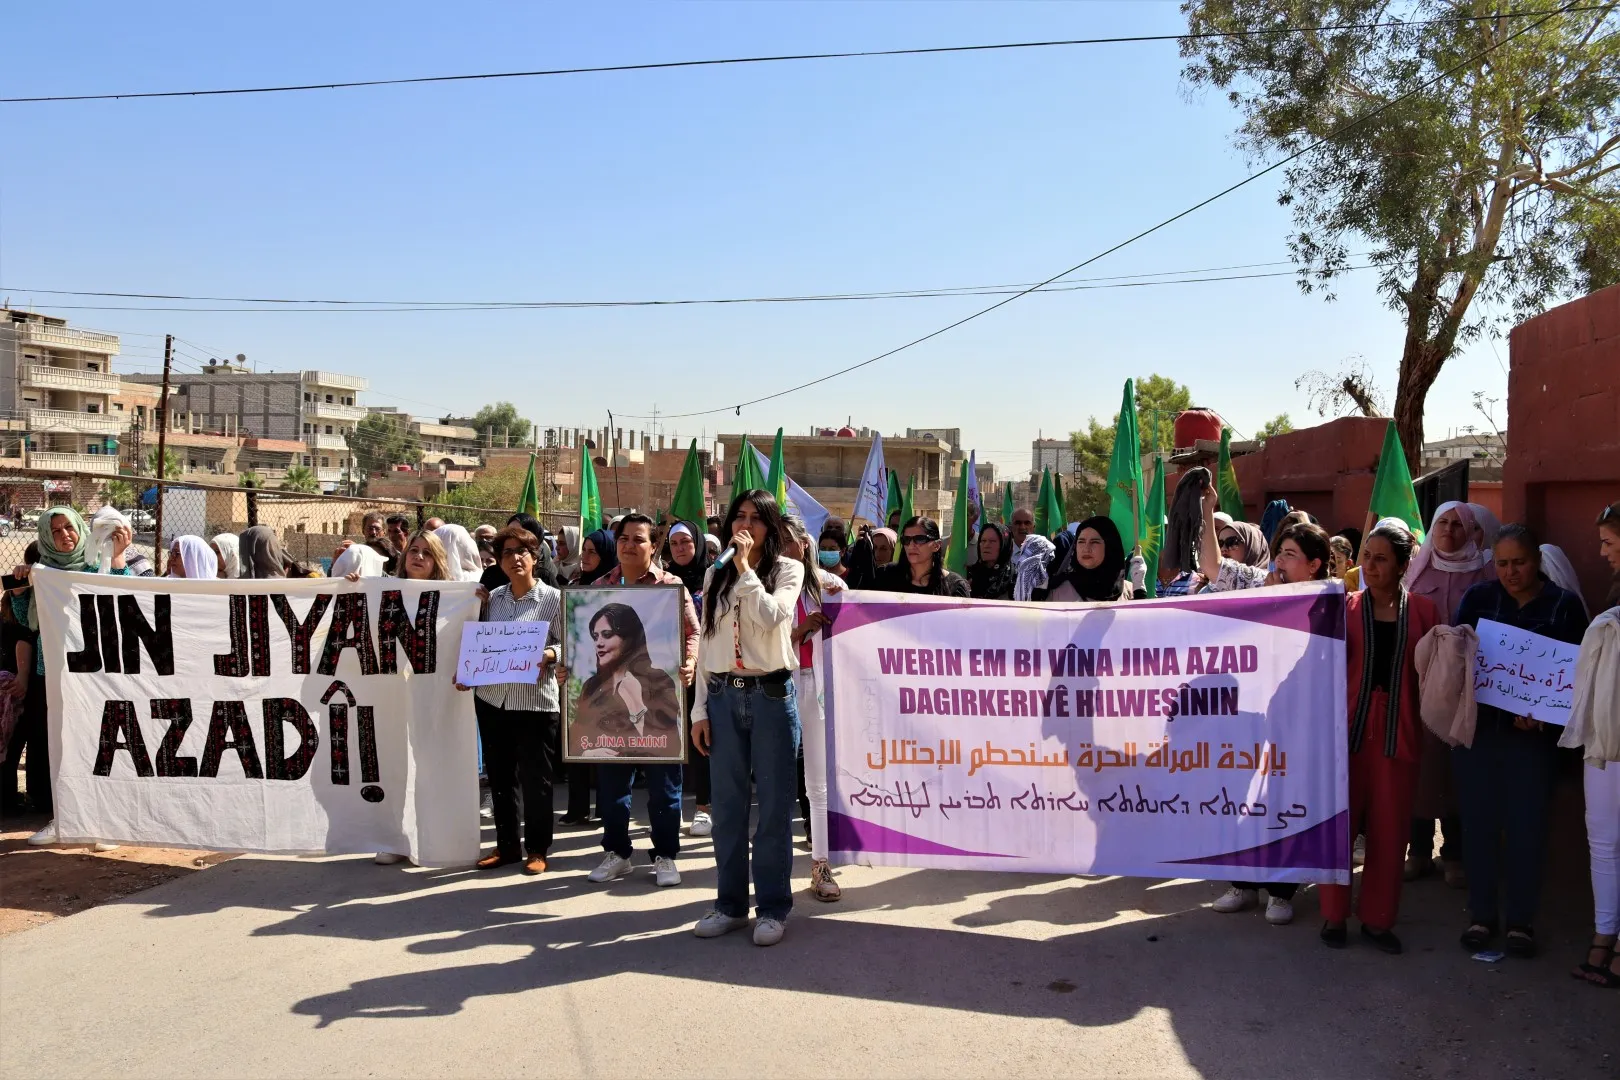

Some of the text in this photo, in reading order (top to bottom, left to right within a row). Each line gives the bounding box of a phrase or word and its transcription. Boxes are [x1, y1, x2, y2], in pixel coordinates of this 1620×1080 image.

[67, 589, 440, 677] JIN JIYAN
[475, 624, 497, 643] العالم
[1499, 633, 1533, 654] ثورة
[877, 642, 1259, 677] WERIN EM BI VÎNA JINA AZAD
[1472, 670, 1494, 691] المرأ
[898, 684, 1070, 718] DAGIRKERIYÊ
[1076, 682, 1239, 722] HILWEŞÎNIN
[93, 679, 385, 803] AZADÎ!
[866, 735, 1287, 777] بإرادة المرأة الحرة سنحطم الإحتلال
